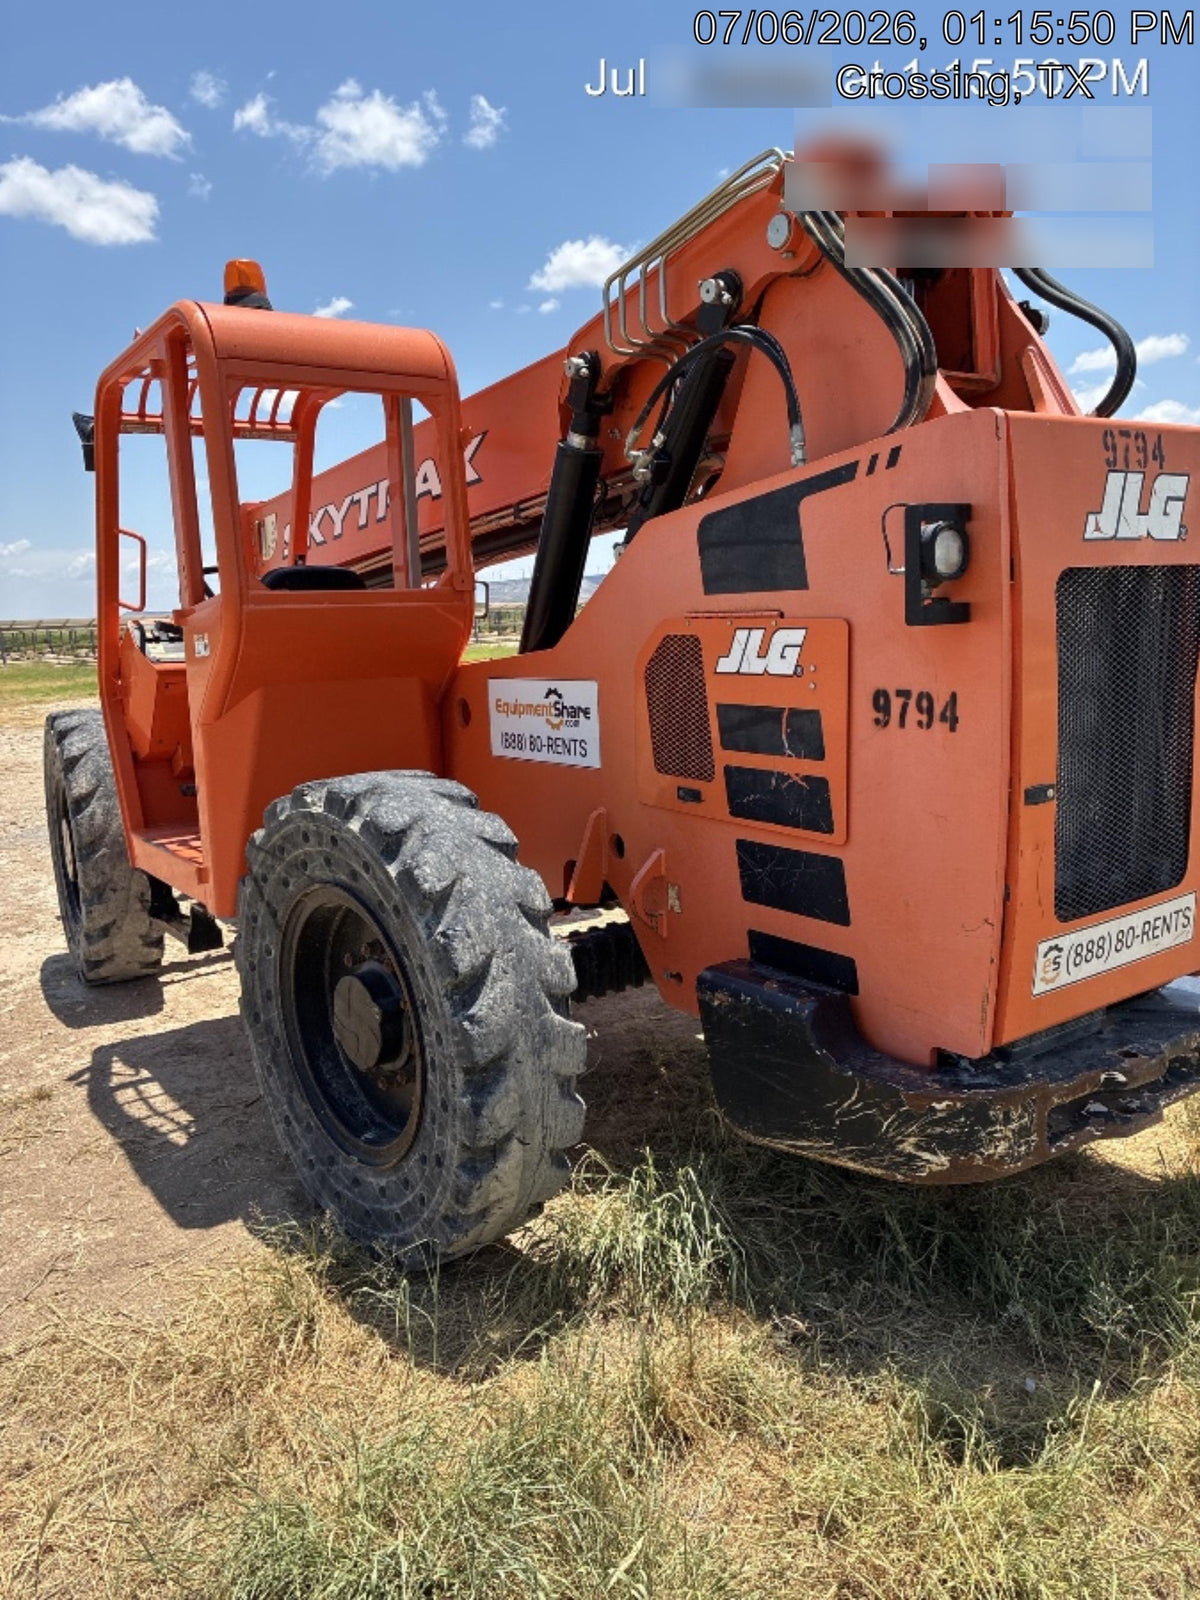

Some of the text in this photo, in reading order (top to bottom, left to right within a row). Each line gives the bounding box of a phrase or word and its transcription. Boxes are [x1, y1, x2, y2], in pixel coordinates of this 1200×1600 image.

[1102, 429, 1165, 469] 9794
[1083, 470, 1190, 541] JLG
[714, 627, 808, 677] JLG
[872, 688, 959, 733] 9794
[529, 733, 588, 758] 80-RENTS
[1066, 931, 1113, 976] (888)
[1114, 906, 1191, 953] 80-RENTS
